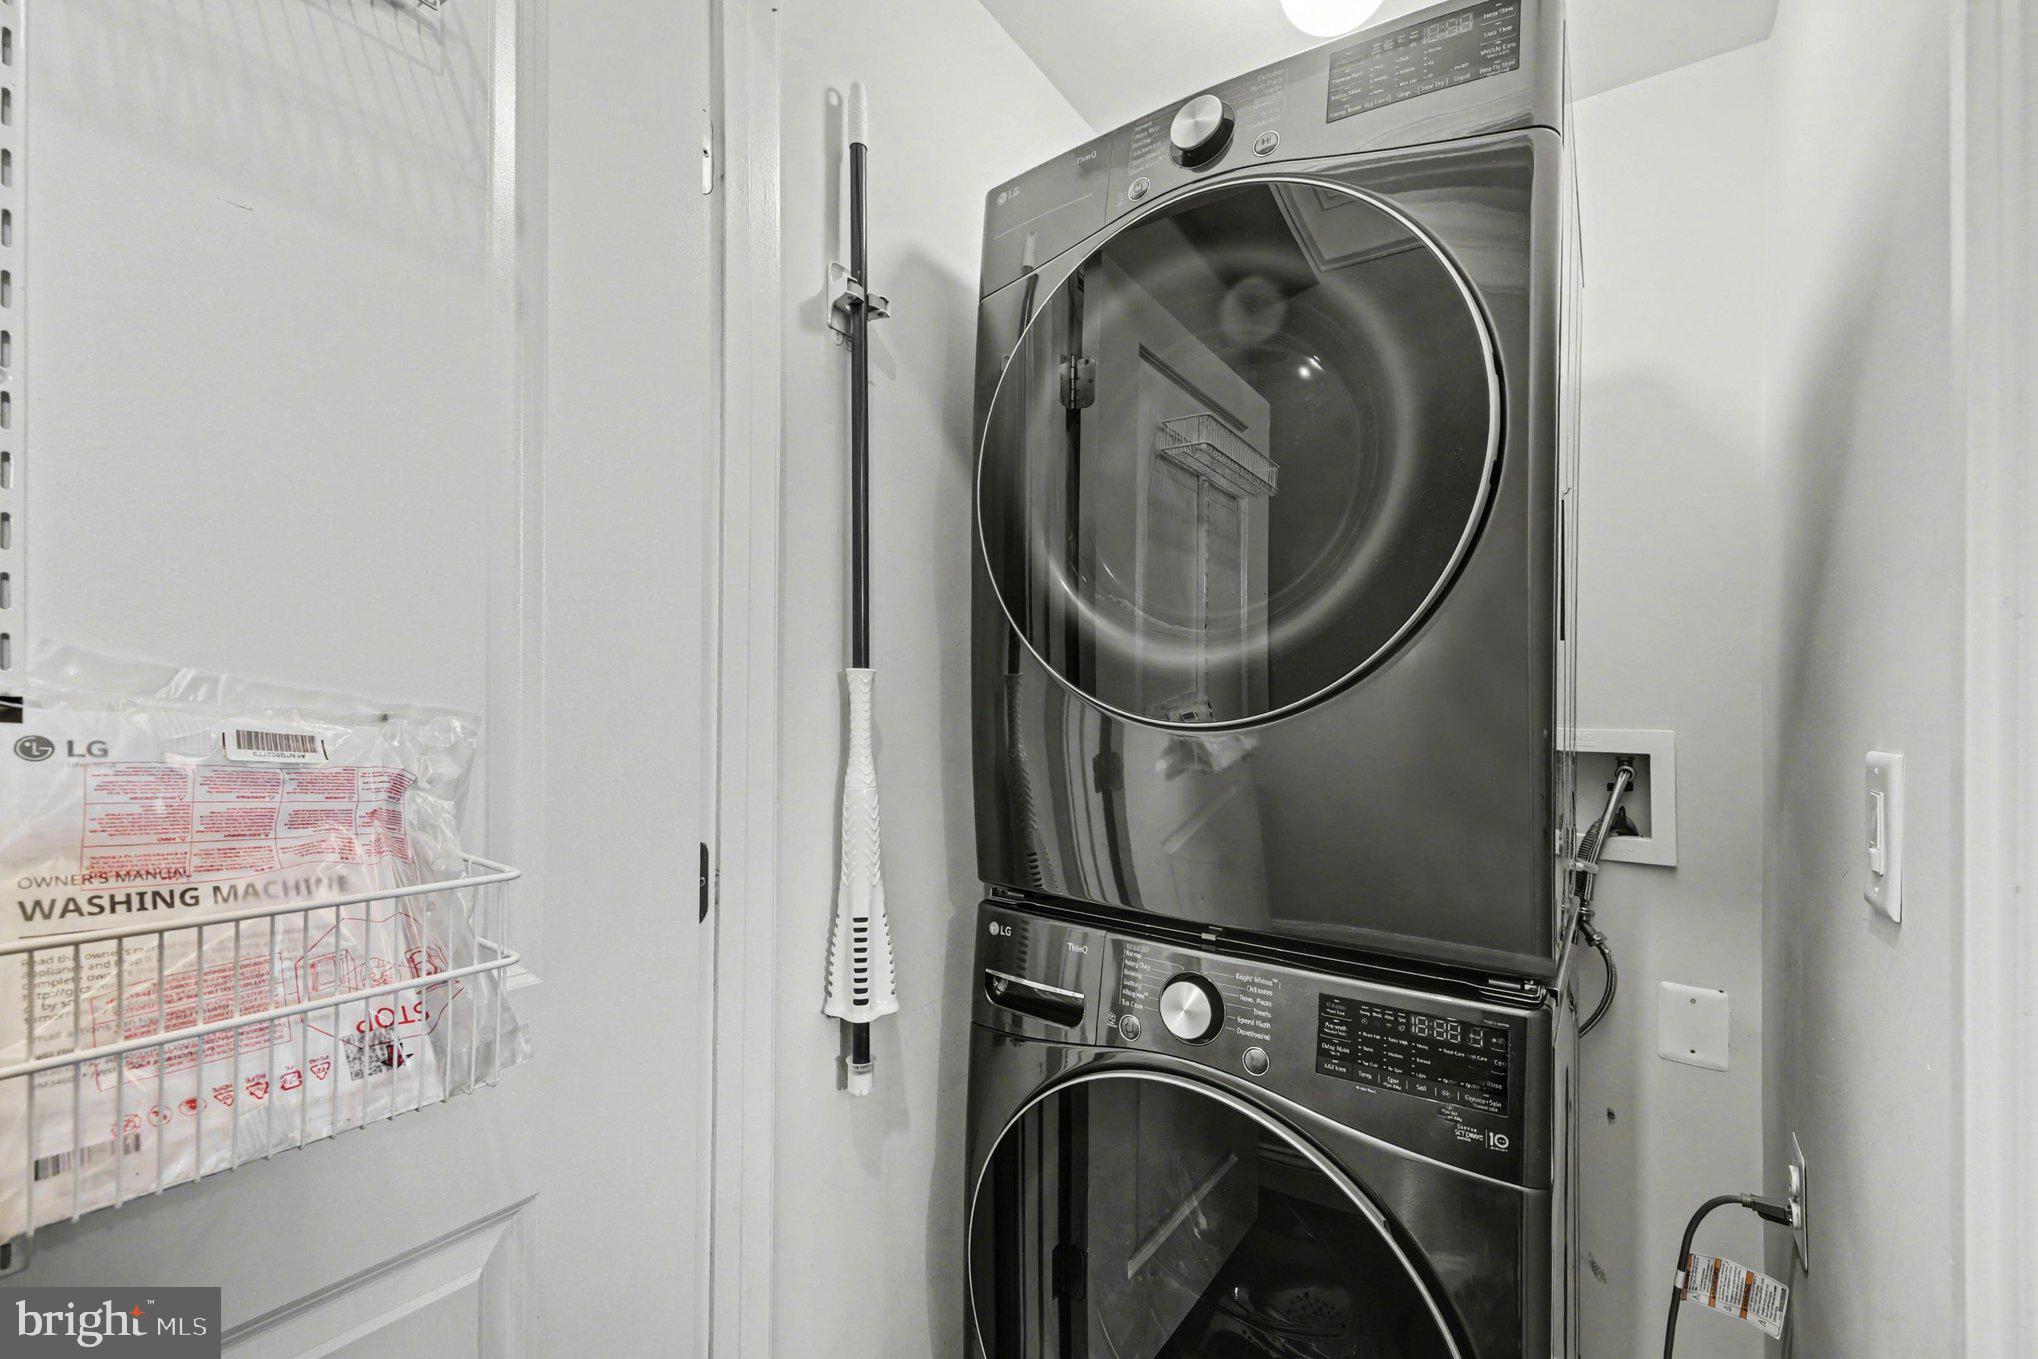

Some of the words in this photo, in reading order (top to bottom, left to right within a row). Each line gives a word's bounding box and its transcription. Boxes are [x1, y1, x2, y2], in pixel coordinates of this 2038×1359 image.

[1008, 187, 1020, 199] LG
[66, 739, 109, 758] LG
[17, 871, 108, 890] OWNER'S
[17, 886, 200, 922] WASHING
[212, 873, 349, 905] MACHINE
[1000, 926, 1012, 936] LG
[1067, 942, 1089, 955] ThinQ
[88, 960, 111, 971] and
[356, 1001, 430, 1033] STOP
